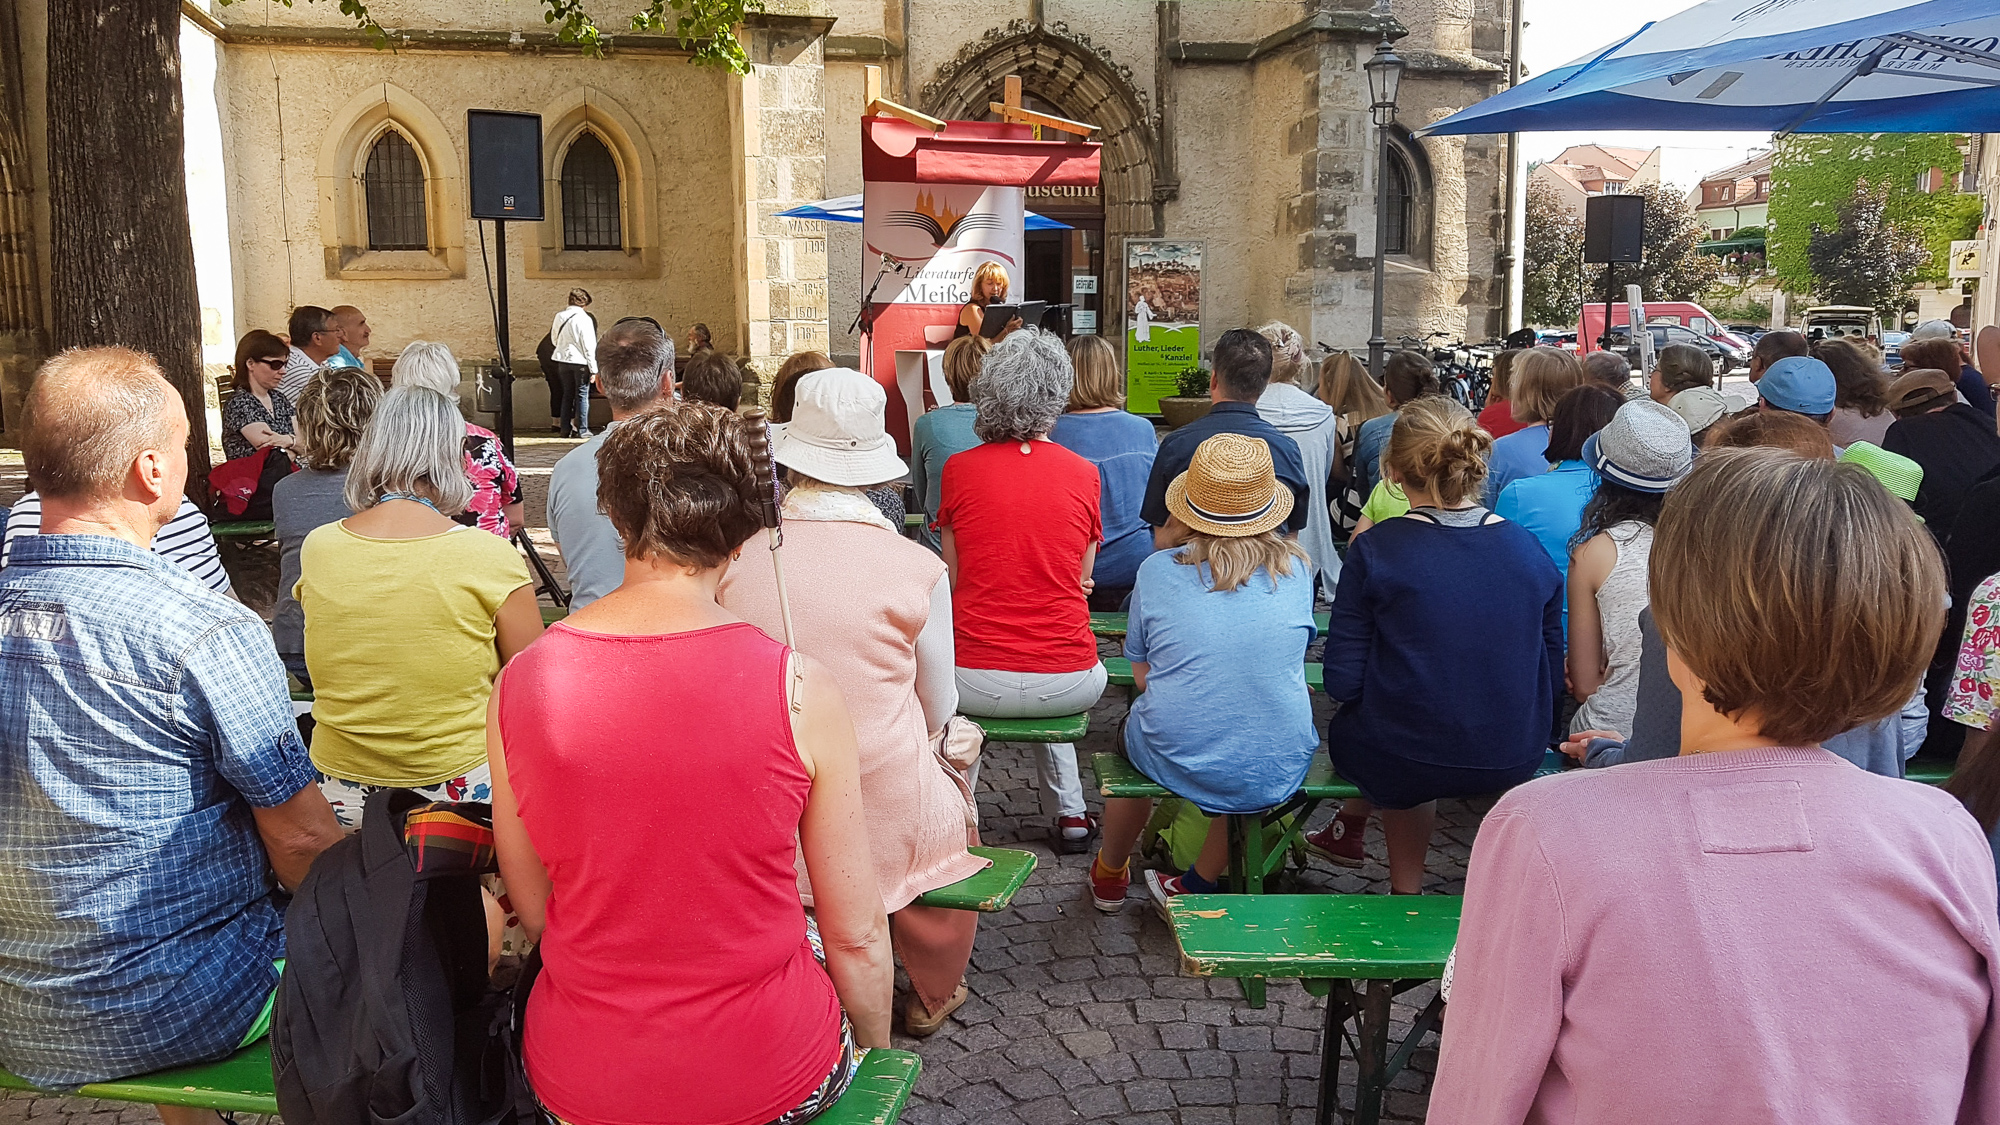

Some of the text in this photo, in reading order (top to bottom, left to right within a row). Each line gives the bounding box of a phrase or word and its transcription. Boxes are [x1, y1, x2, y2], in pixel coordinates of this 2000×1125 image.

[1024, 185, 1098, 197] useum
[904, 266, 974, 284] Literaturfe
[904, 283, 970, 303] Meiße
[795, 306, 817, 319] 1501
[1133, 345, 1160, 353] Luther,
